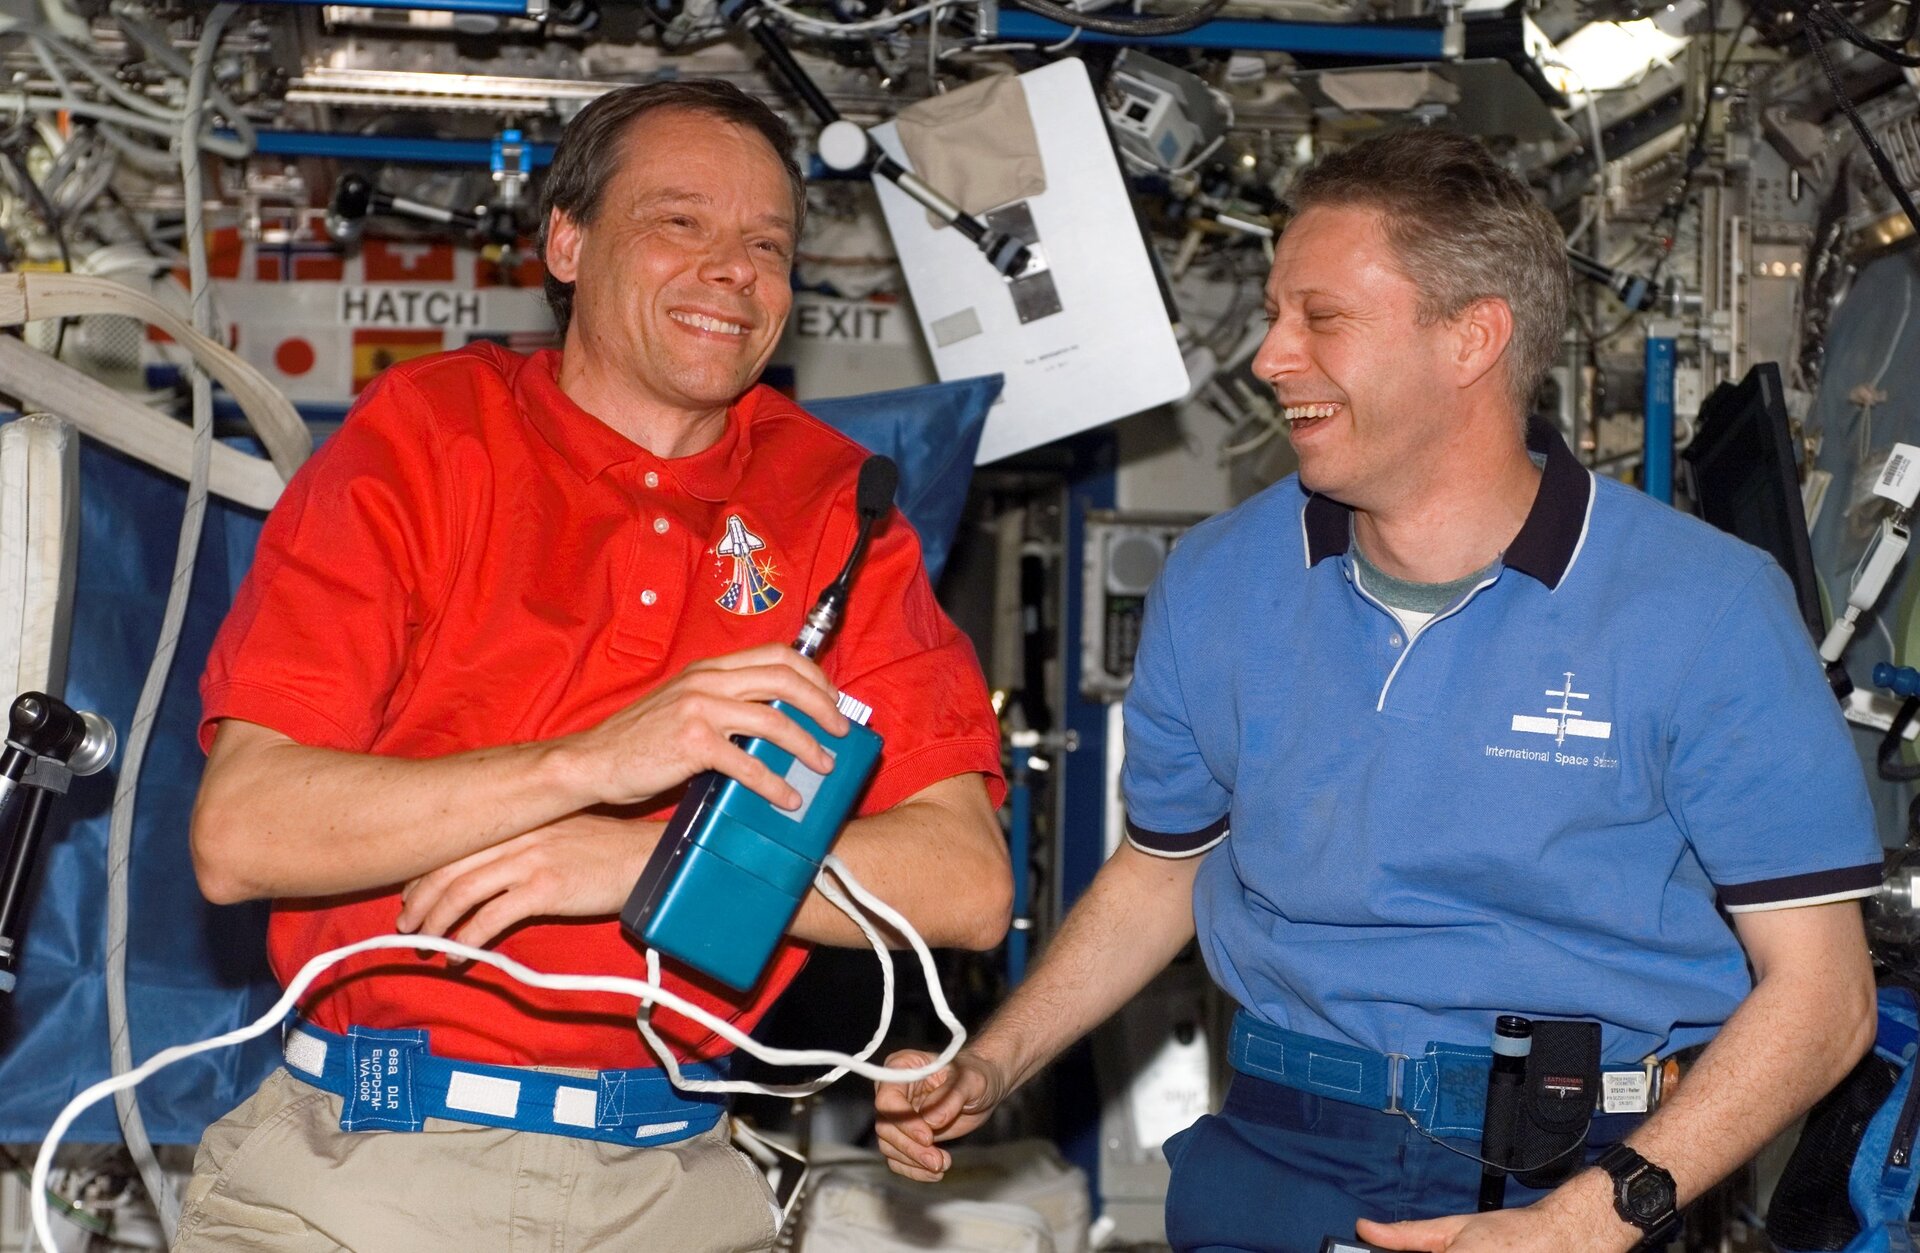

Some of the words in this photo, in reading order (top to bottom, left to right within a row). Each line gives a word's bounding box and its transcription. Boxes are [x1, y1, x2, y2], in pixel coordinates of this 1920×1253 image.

[343, 288, 480, 326] HATCH
[796, 304, 890, 339] EXIT
[1485, 744, 1550, 762] International
[1554, 752, 1589, 766] Space
[388, 1048, 399, 1076] esa
[360, 1058, 370, 1102] IVA-006
[386, 1085, 399, 1110] DLR
